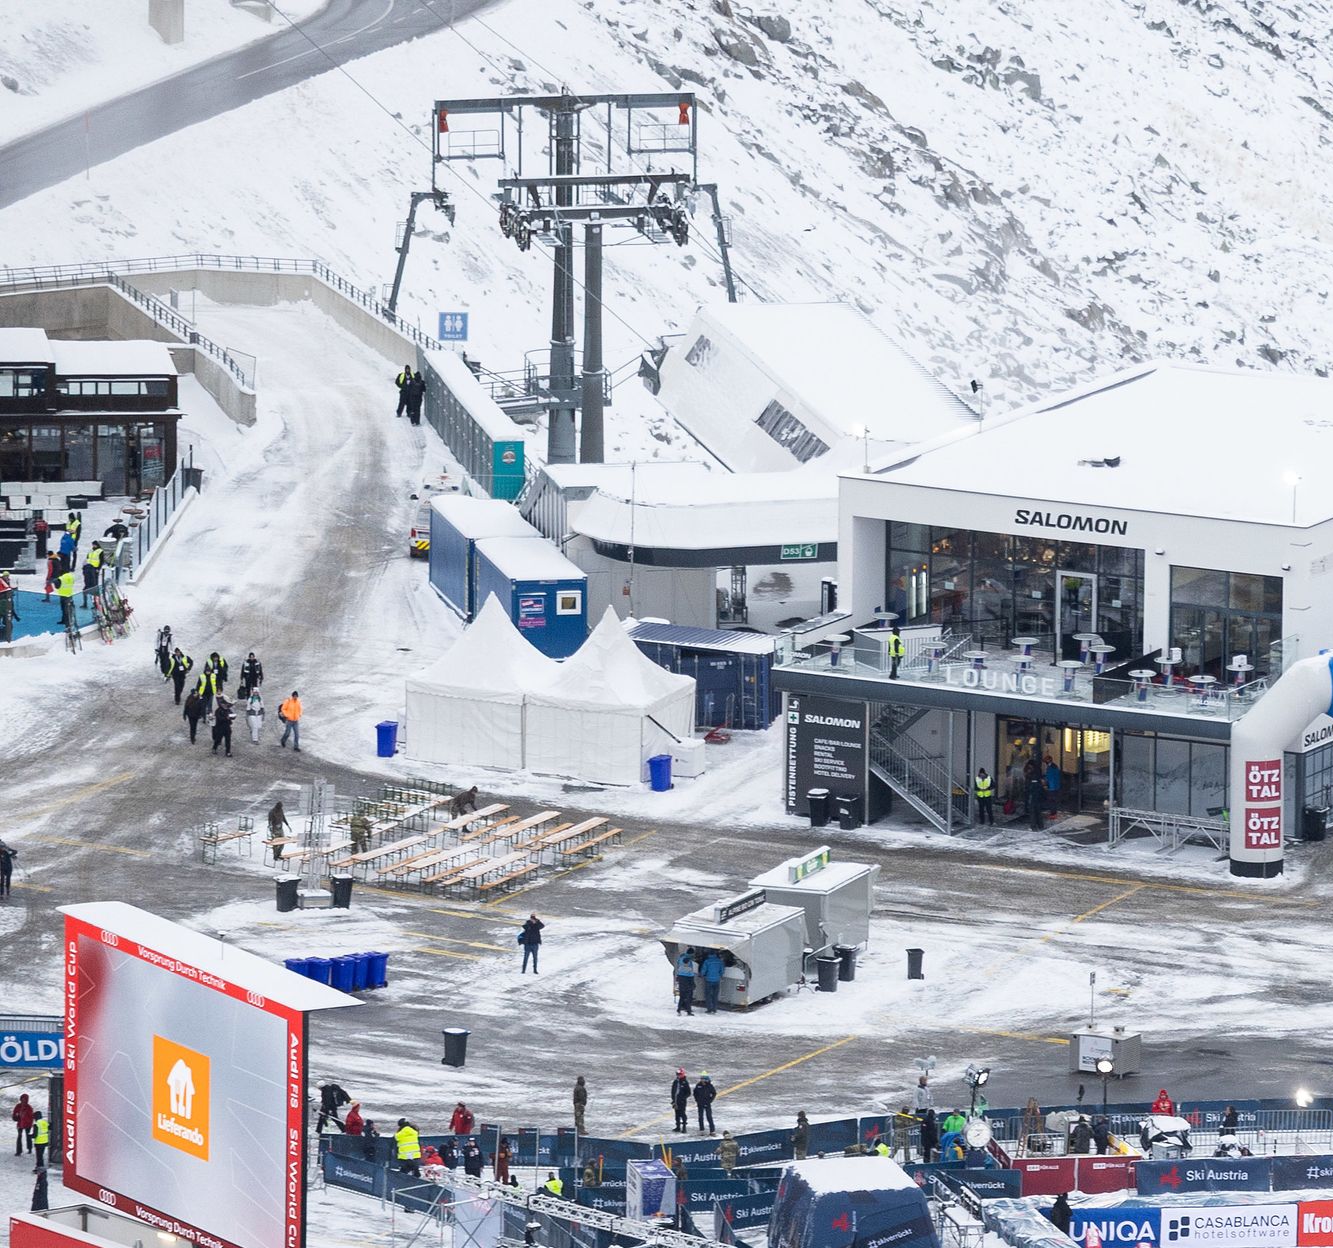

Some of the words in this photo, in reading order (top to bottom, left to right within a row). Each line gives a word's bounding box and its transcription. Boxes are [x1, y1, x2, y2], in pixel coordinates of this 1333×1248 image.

[1014, 509, 1128, 535] SALOMON
[783, 547, 800, 556] D53
[946, 667, 1056, 696] LOUNGE
[804, 714, 861, 729] SALOMON
[788, 727, 797, 807] PISTENRETTUNG
[1248, 765, 1279, 783] ÖTZ
[1248, 785, 1279, 798] TAL
[1248, 812, 1279, 830] ÖTZ
[1248, 832, 1279, 845] TAL
[67, 941, 78, 976] Cup
[137, 945, 175, 972] Vorsprung
[175, 961, 198, 980] Durch
[198, 970, 226, 991] Technik
[67, 981, 77, 1038] World
[67, 1040, 76, 1071] Ski
[290, 1032, 300, 1081] Audi
[67, 1090, 76, 1115] FIS
[290, 1084, 299, 1109] FIS
[66, 1119, 75, 1164] Audi
[157, 1112, 204, 1146] Lieferando
[290, 1128, 298, 1157] Ski
[739, 1142, 782, 1157] #skiverrückt
[1186, 1170, 1205, 1182] Ski
[1207, 1169, 1249, 1181] Austria
[289, 1161, 299, 1220] World
[690, 1193, 708, 1202] Ski
[136, 1206, 173, 1233] Vorsprung
[173, 1221, 195, 1242] Durch
[735, 1209, 749, 1219] Ski
[1195, 1214, 1290, 1229] CASABLANCA
[1069, 1220, 1156, 1242] UNIQA
[1195, 1228, 1290, 1240] hotelsoftware
